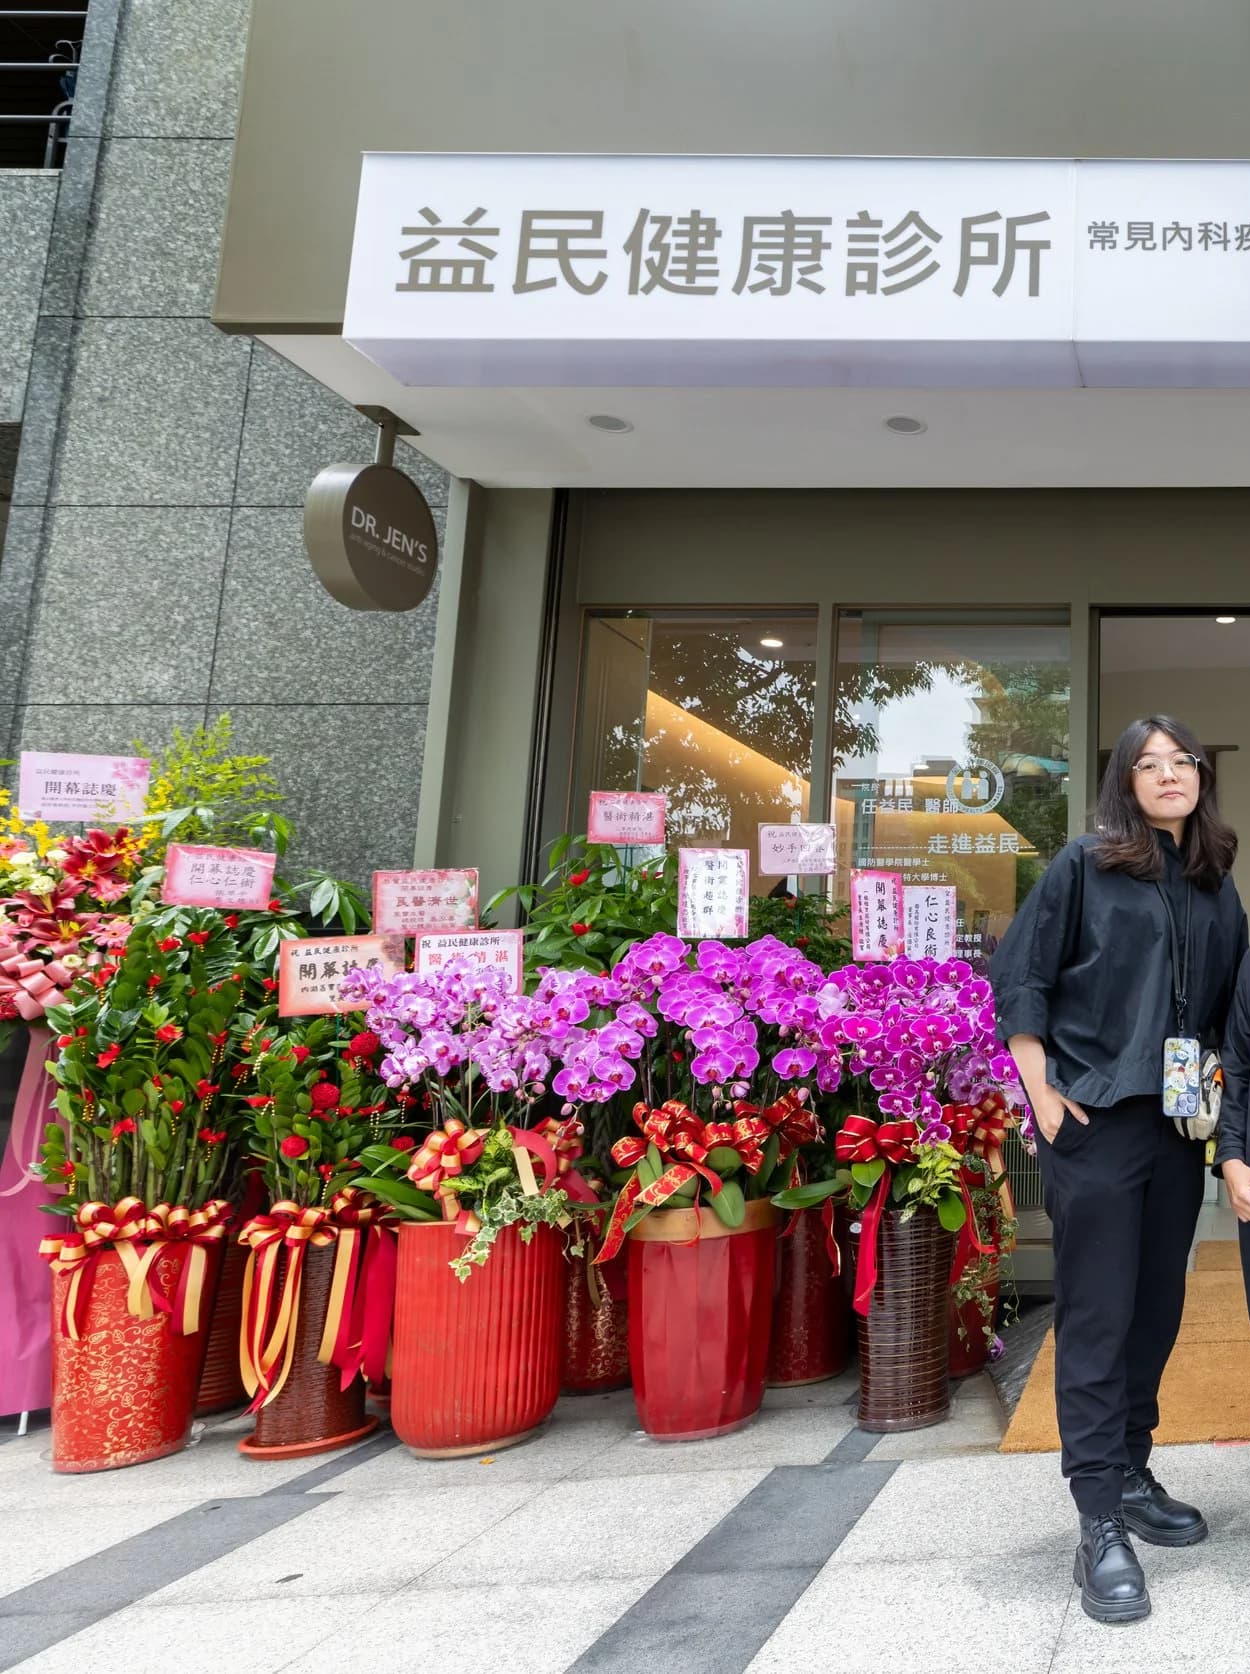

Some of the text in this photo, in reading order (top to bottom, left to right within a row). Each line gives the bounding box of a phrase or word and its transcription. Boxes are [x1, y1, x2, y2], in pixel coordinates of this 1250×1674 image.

[394, 206, 1052, 298] 益民健康診所
[351, 505, 380, 539] DR.
[383, 525, 428, 563] JEN'S
[45, 781, 116, 797] 開幕誌慶
[861, 798, 959, 815] 任益民 醫師
[927, 833, 1020, 855] 走進益民
[190, 863, 256, 878] 開幕誌慶
[189, 874, 256, 889] 仁心仁術
[875, 881, 889, 949] 開幕誌慶
[924, 894, 939, 958] 仁心良術
[305, 944, 359, 957] 益民健康診所
[421, 936, 500, 949] 祝 益民健康診所
